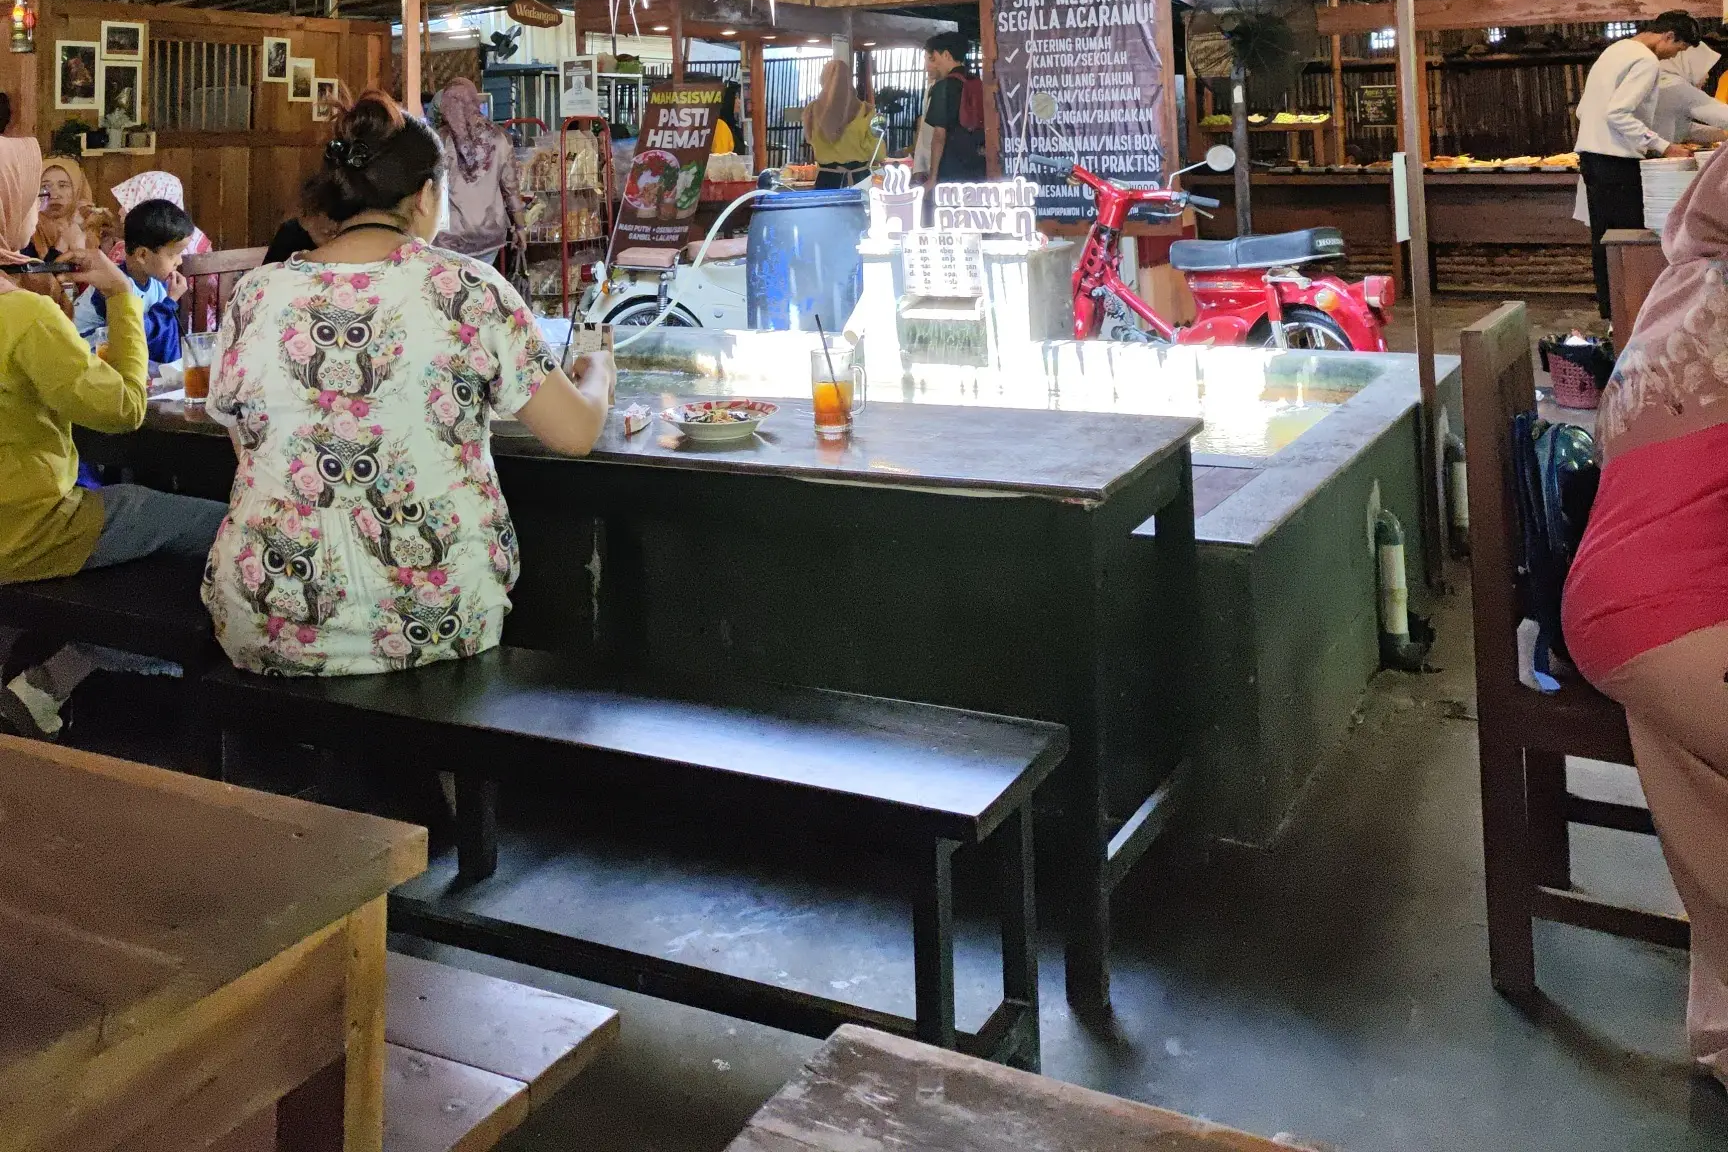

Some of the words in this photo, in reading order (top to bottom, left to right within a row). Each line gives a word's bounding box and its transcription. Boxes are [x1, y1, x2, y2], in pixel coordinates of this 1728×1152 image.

[514, 3, 559, 23] Wedangan
[998, 8, 1061, 33] SEGALA
[1065, 2, 1155, 29] ACARAMU!
[1025, 38, 1073, 54] CATERING
[1074, 36, 1112, 51] RUMAH
[1028, 74, 1059, 89] ACARA
[1061, 72, 1096, 88] ULANG
[1098, 71, 1134, 86] TAHUN
[650, 90, 723, 105] MAHASISWA
[1028, 86, 1141, 105] ASAN/KEAGAMAAN
[657, 107, 710, 127] PASTI
[646, 128, 712, 148] HEMAT
[1004, 137, 1028, 154] BISA
[1134, 133, 1159, 151] BOX
[1101, 154, 1160, 173] PRAKTIS!
[938, 179, 1037, 207] mampir
[1038, 184, 1080, 198] MESANAN
[939, 209, 1032, 241] pawon
